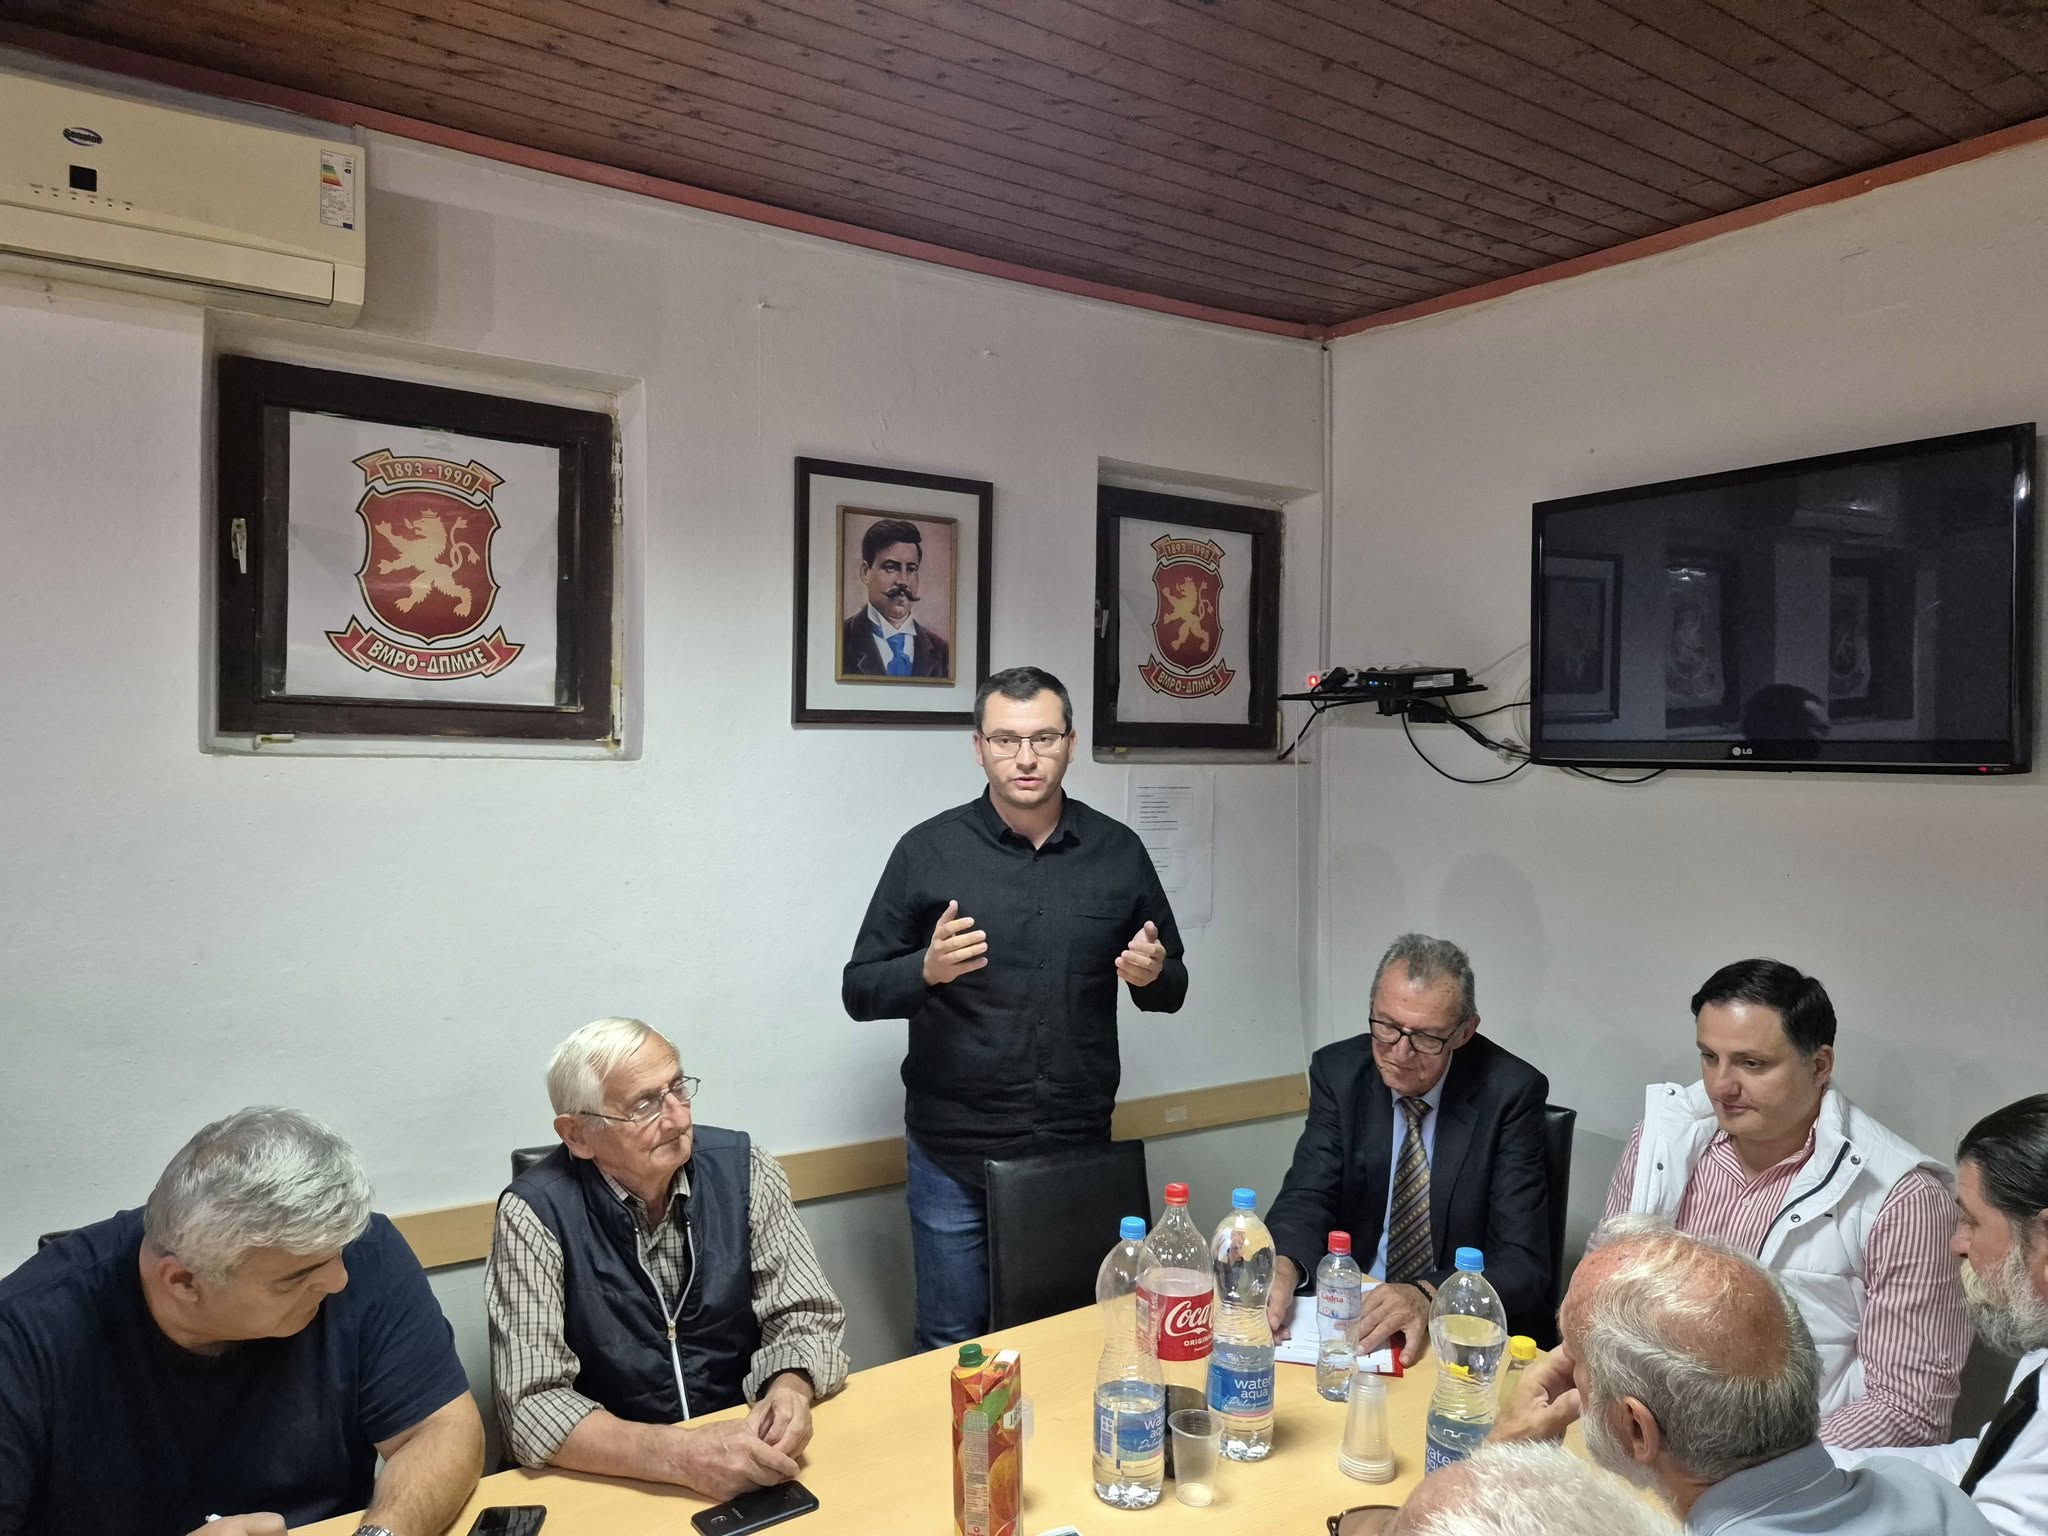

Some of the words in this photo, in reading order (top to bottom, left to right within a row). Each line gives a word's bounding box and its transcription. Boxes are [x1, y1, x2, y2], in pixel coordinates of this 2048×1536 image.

[367, 640, 487, 674] ВМРО-ДПМНЕ
[1157, 671, 1217, 693] ВМРО-ДПМНЕ
[1234, 1376, 1272, 1390] water
[1240, 1388, 1268, 1400] aqua
